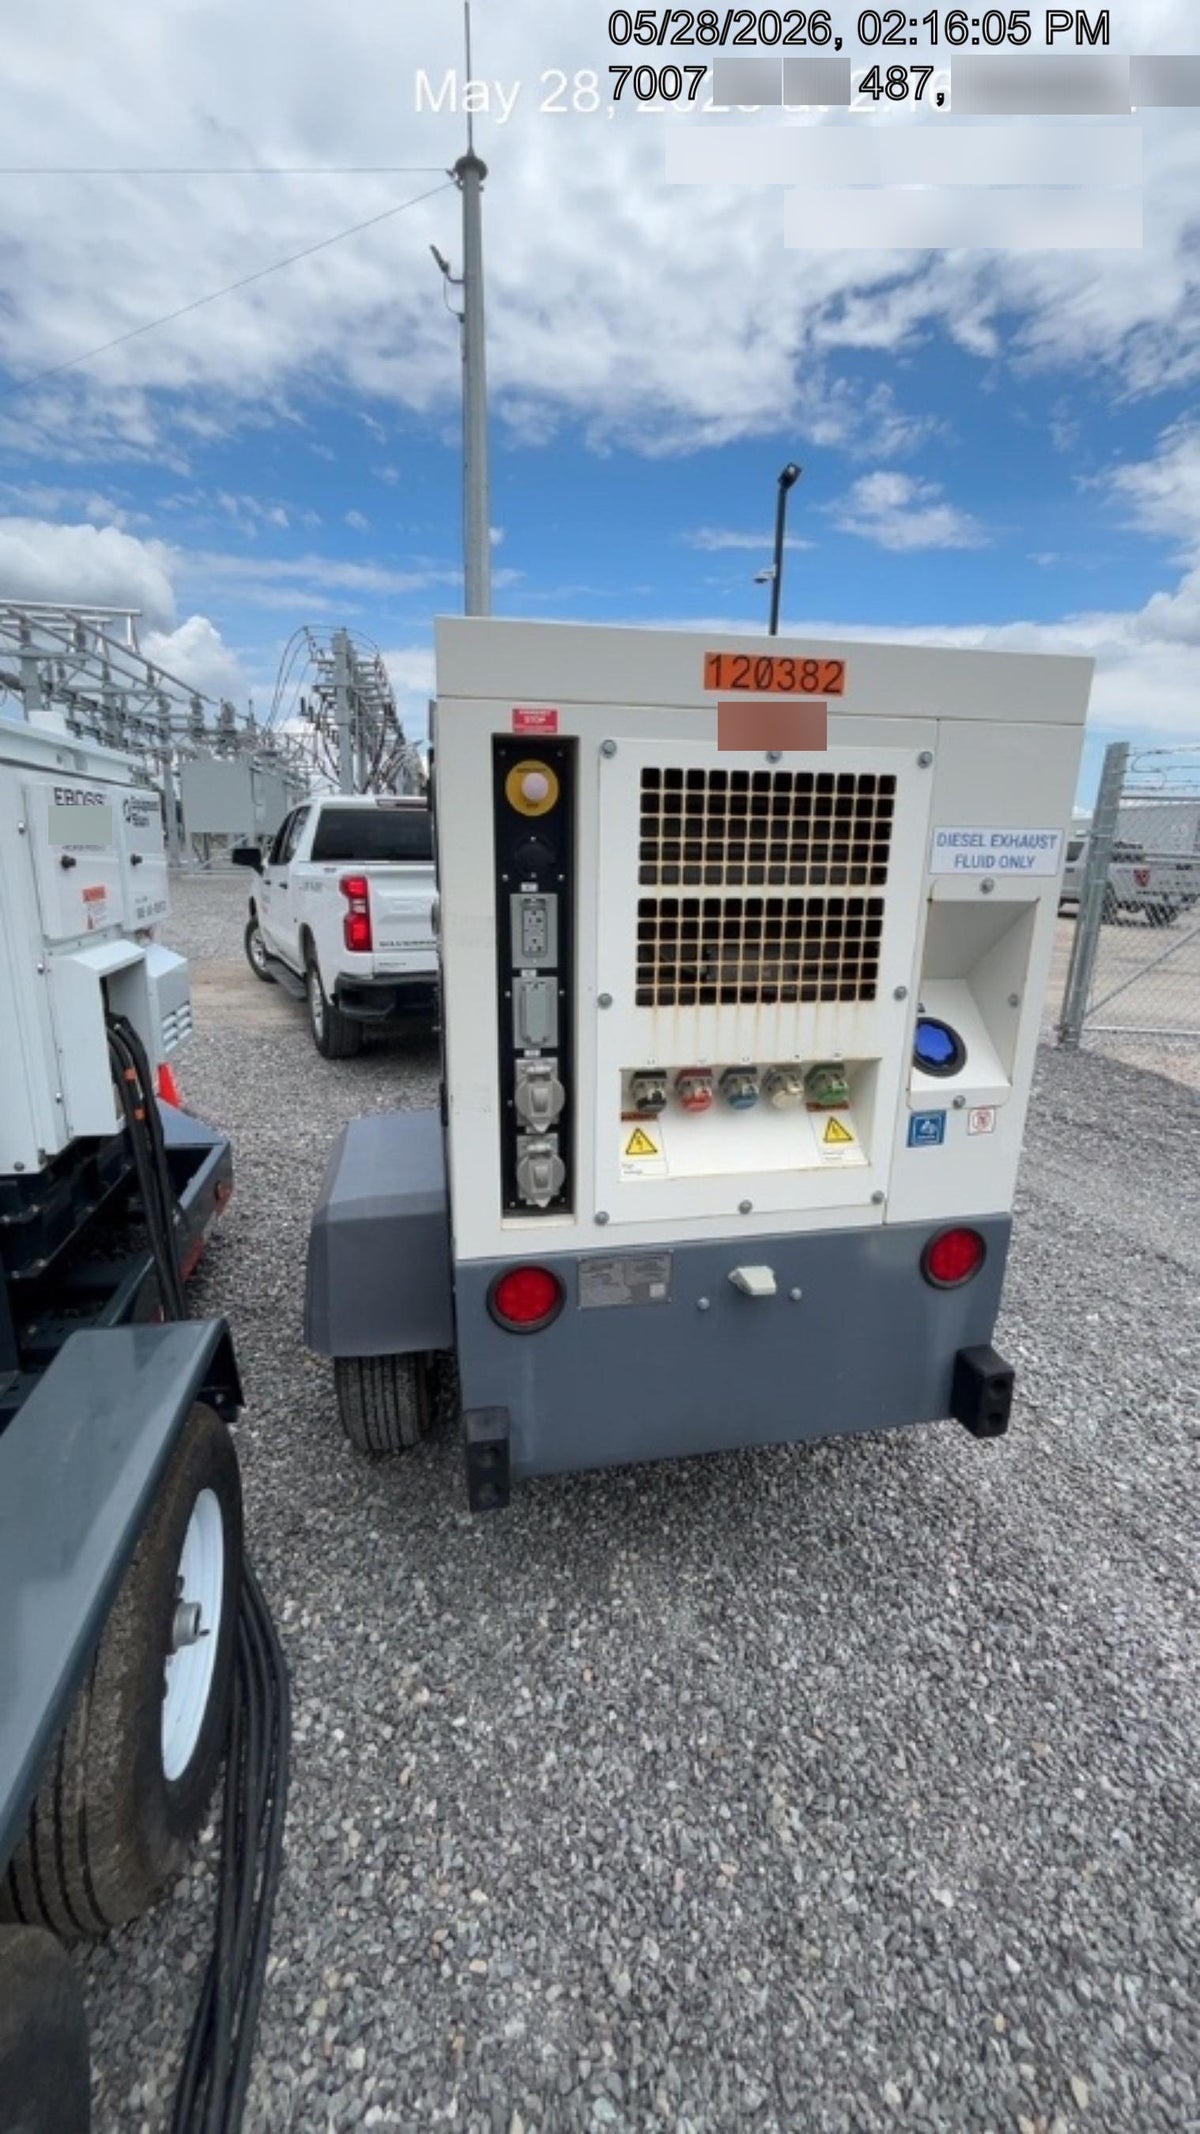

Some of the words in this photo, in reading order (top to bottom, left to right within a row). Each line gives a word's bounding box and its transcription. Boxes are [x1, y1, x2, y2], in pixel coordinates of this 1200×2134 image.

[709, 654, 843, 693] 120382
[936, 832, 985, 848] DIESEL
[991, 834, 1058, 850] EXHAUST
[954, 853, 995, 869] FLUID
[999, 855, 1036, 869] ONLY
